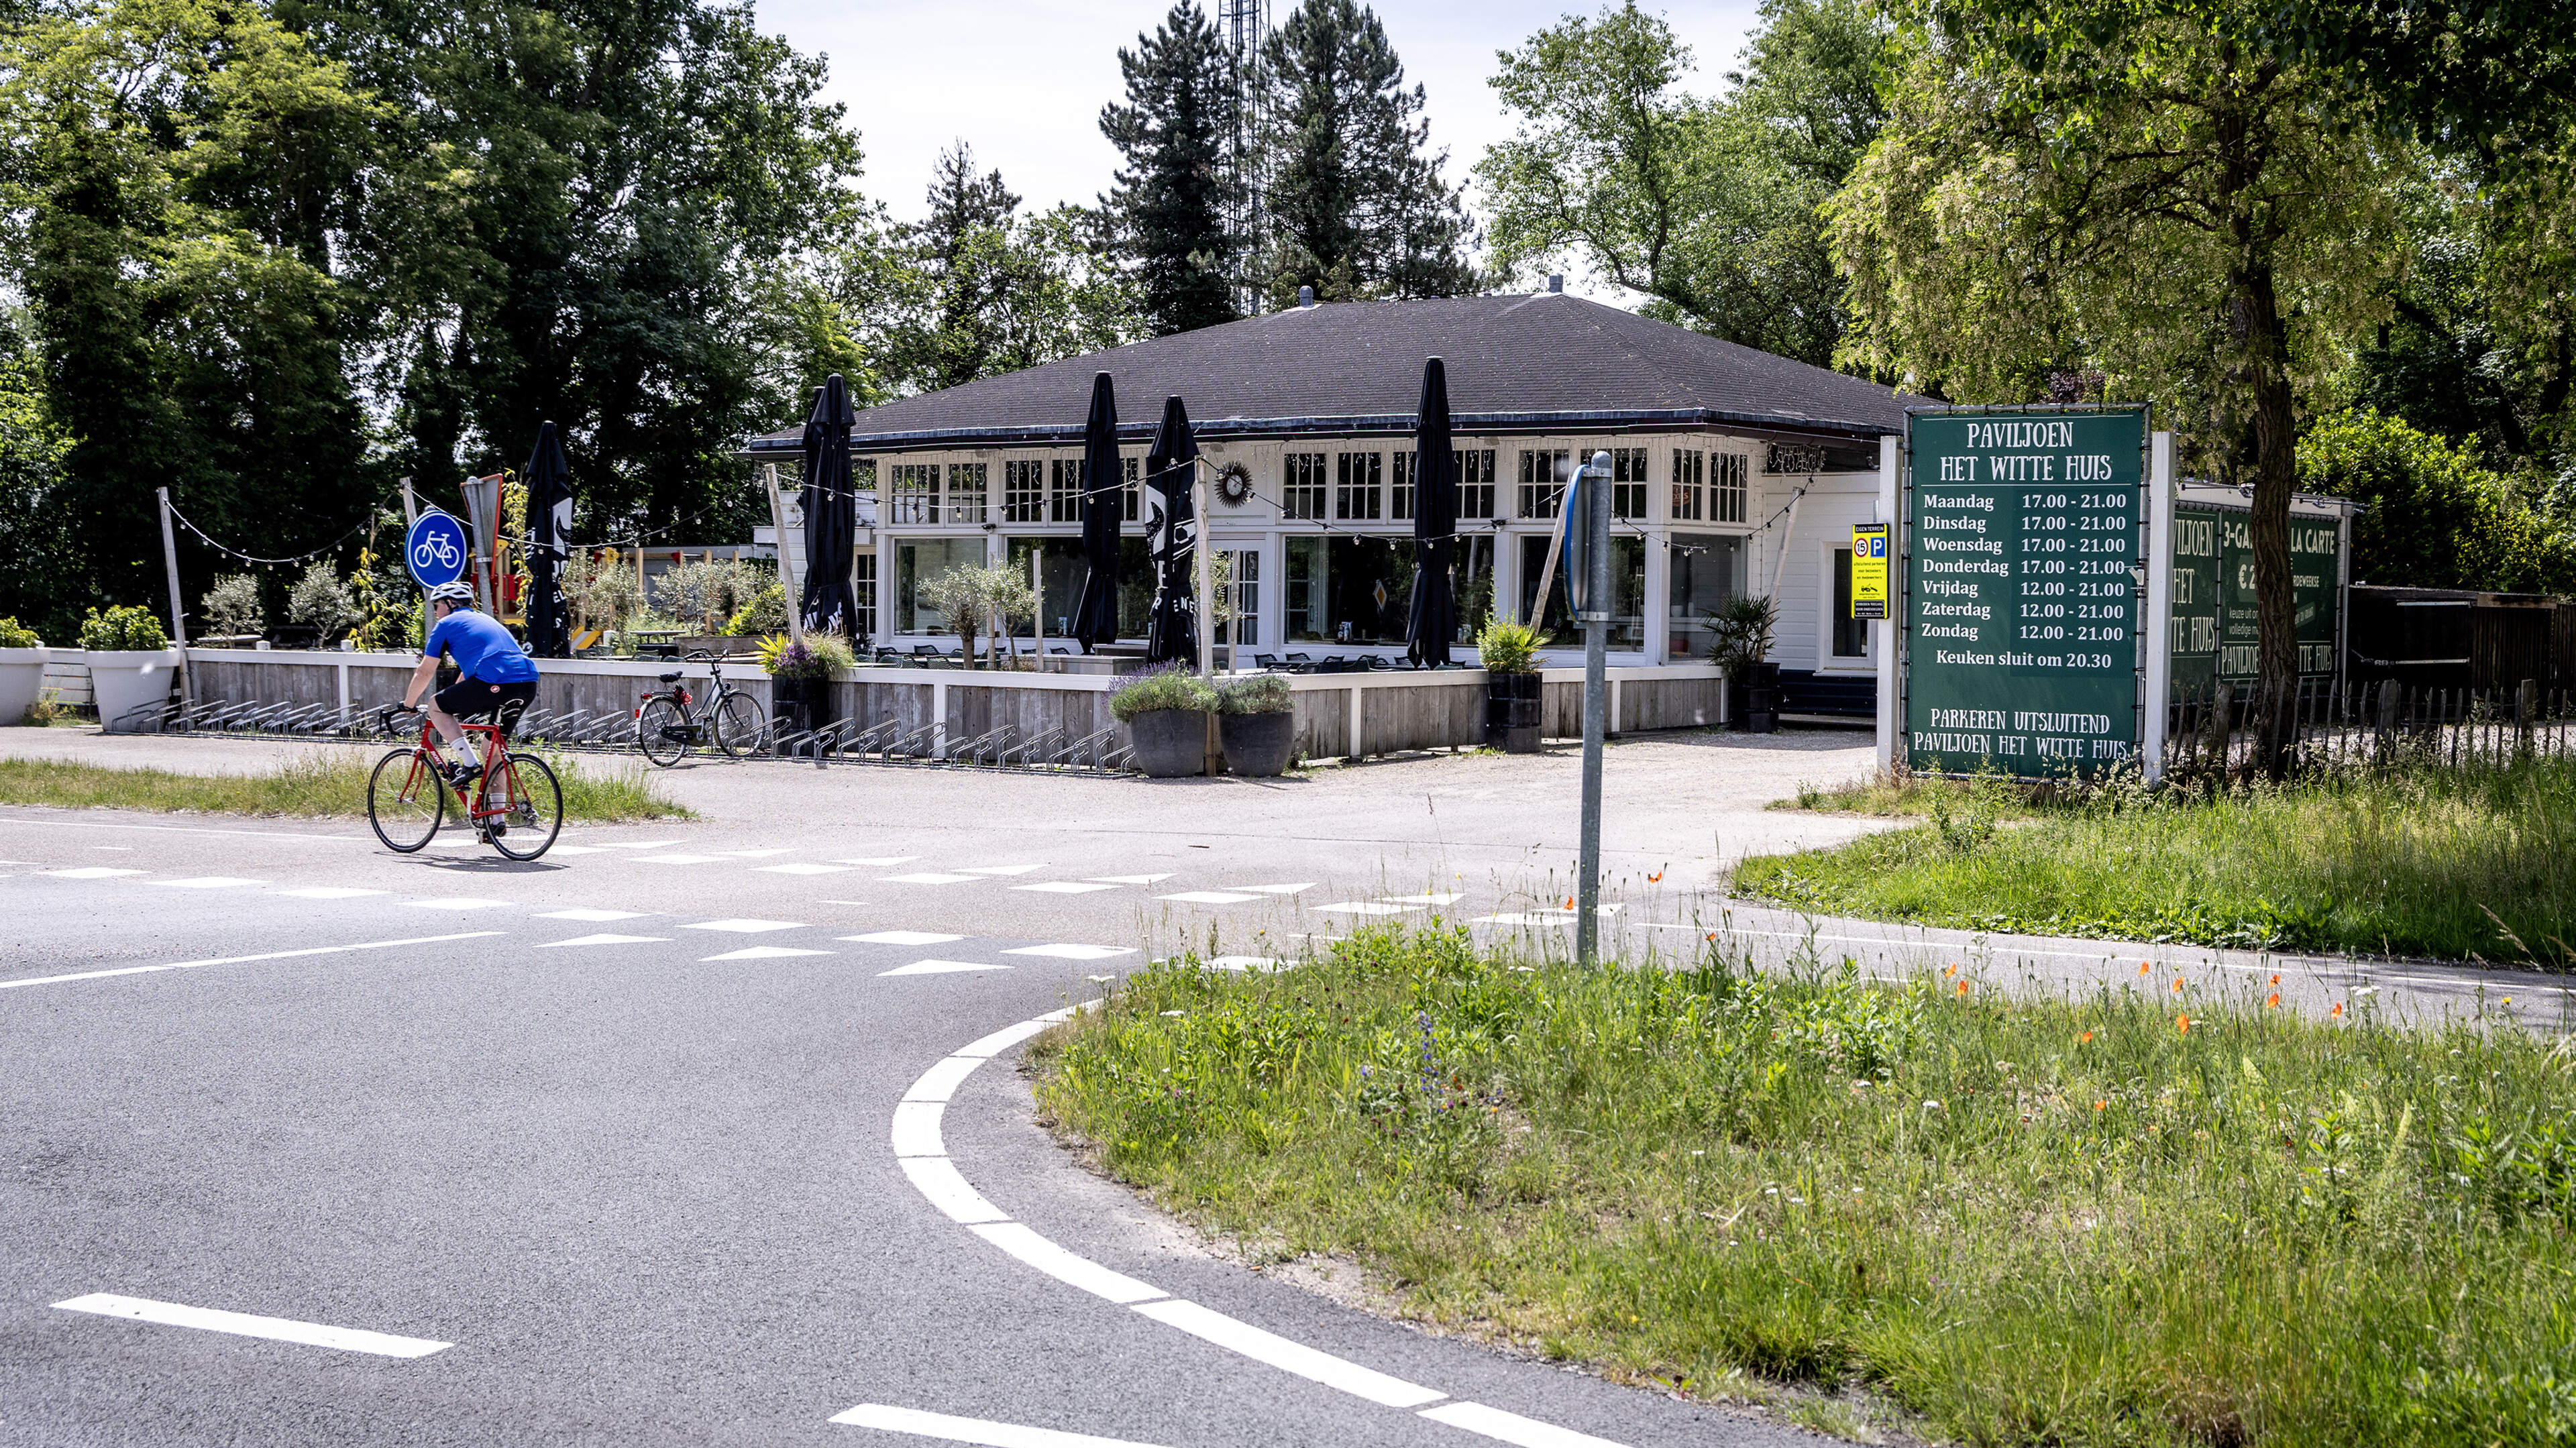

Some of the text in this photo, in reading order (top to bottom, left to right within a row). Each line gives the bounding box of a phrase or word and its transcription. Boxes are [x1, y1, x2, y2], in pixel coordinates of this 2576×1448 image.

[1968, 422, 2073, 447] PAVILJOEN
[1941, 455, 2111, 480] HET WITTE HUIS
[1925, 494, 1994, 511] Maandag
[2023, 495, 2066, 508] 17.00
[2082, 494, 2126, 507] 21.00
[1924, 516, 1986, 533] Dinsdag
[2023, 516, 2065, 530] 17.00
[2081, 516, 2125, 530] 21.00
[1857, 539, 1882, 555] 15 P
[1923, 538, 2002, 555] Woensdag
[2022, 539, 2065, 551] 17.00
[2080, 539, 2125, 552] 21.00
[2291, 526, 2302, 551] LA
[2306, 528, 2334, 555] CARTE
[1923, 559, 2008, 577] Donderdag
[2022, 561, 2064, 573] 17.00
[2080, 561, 2125, 574] 21.00
[1923, 581, 1978, 598] Vrijdag
[2021, 582, 2064, 596] 12.00
[2079, 583, 2124, 596] 21.00
[1923, 602, 1990, 620] Zaterdag
[2021, 604, 2063, 617] 12.00
[2079, 605, 2123, 618] 21.00
[2229, 608, 2244, 618] keuze
[1922, 624, 1978, 641] Zondag
[2021, 626, 2063, 639] 12.00
[2078, 627, 2123, 641] 21.00
[2191, 616, 2214, 651] HUIS
[2229, 624, 2251, 636] volledige
[1937, 650, 2110, 667] Keuken sluit om 20.30
[2222, 646, 2259, 675] PAVILJOE
[2316, 645, 2332, 671] HUIS
[1931, 709, 2109, 733] PARKEREN UITSLUITEND
[1915, 732, 2127, 760] PAVILJOEN HET WITTE HUIS
